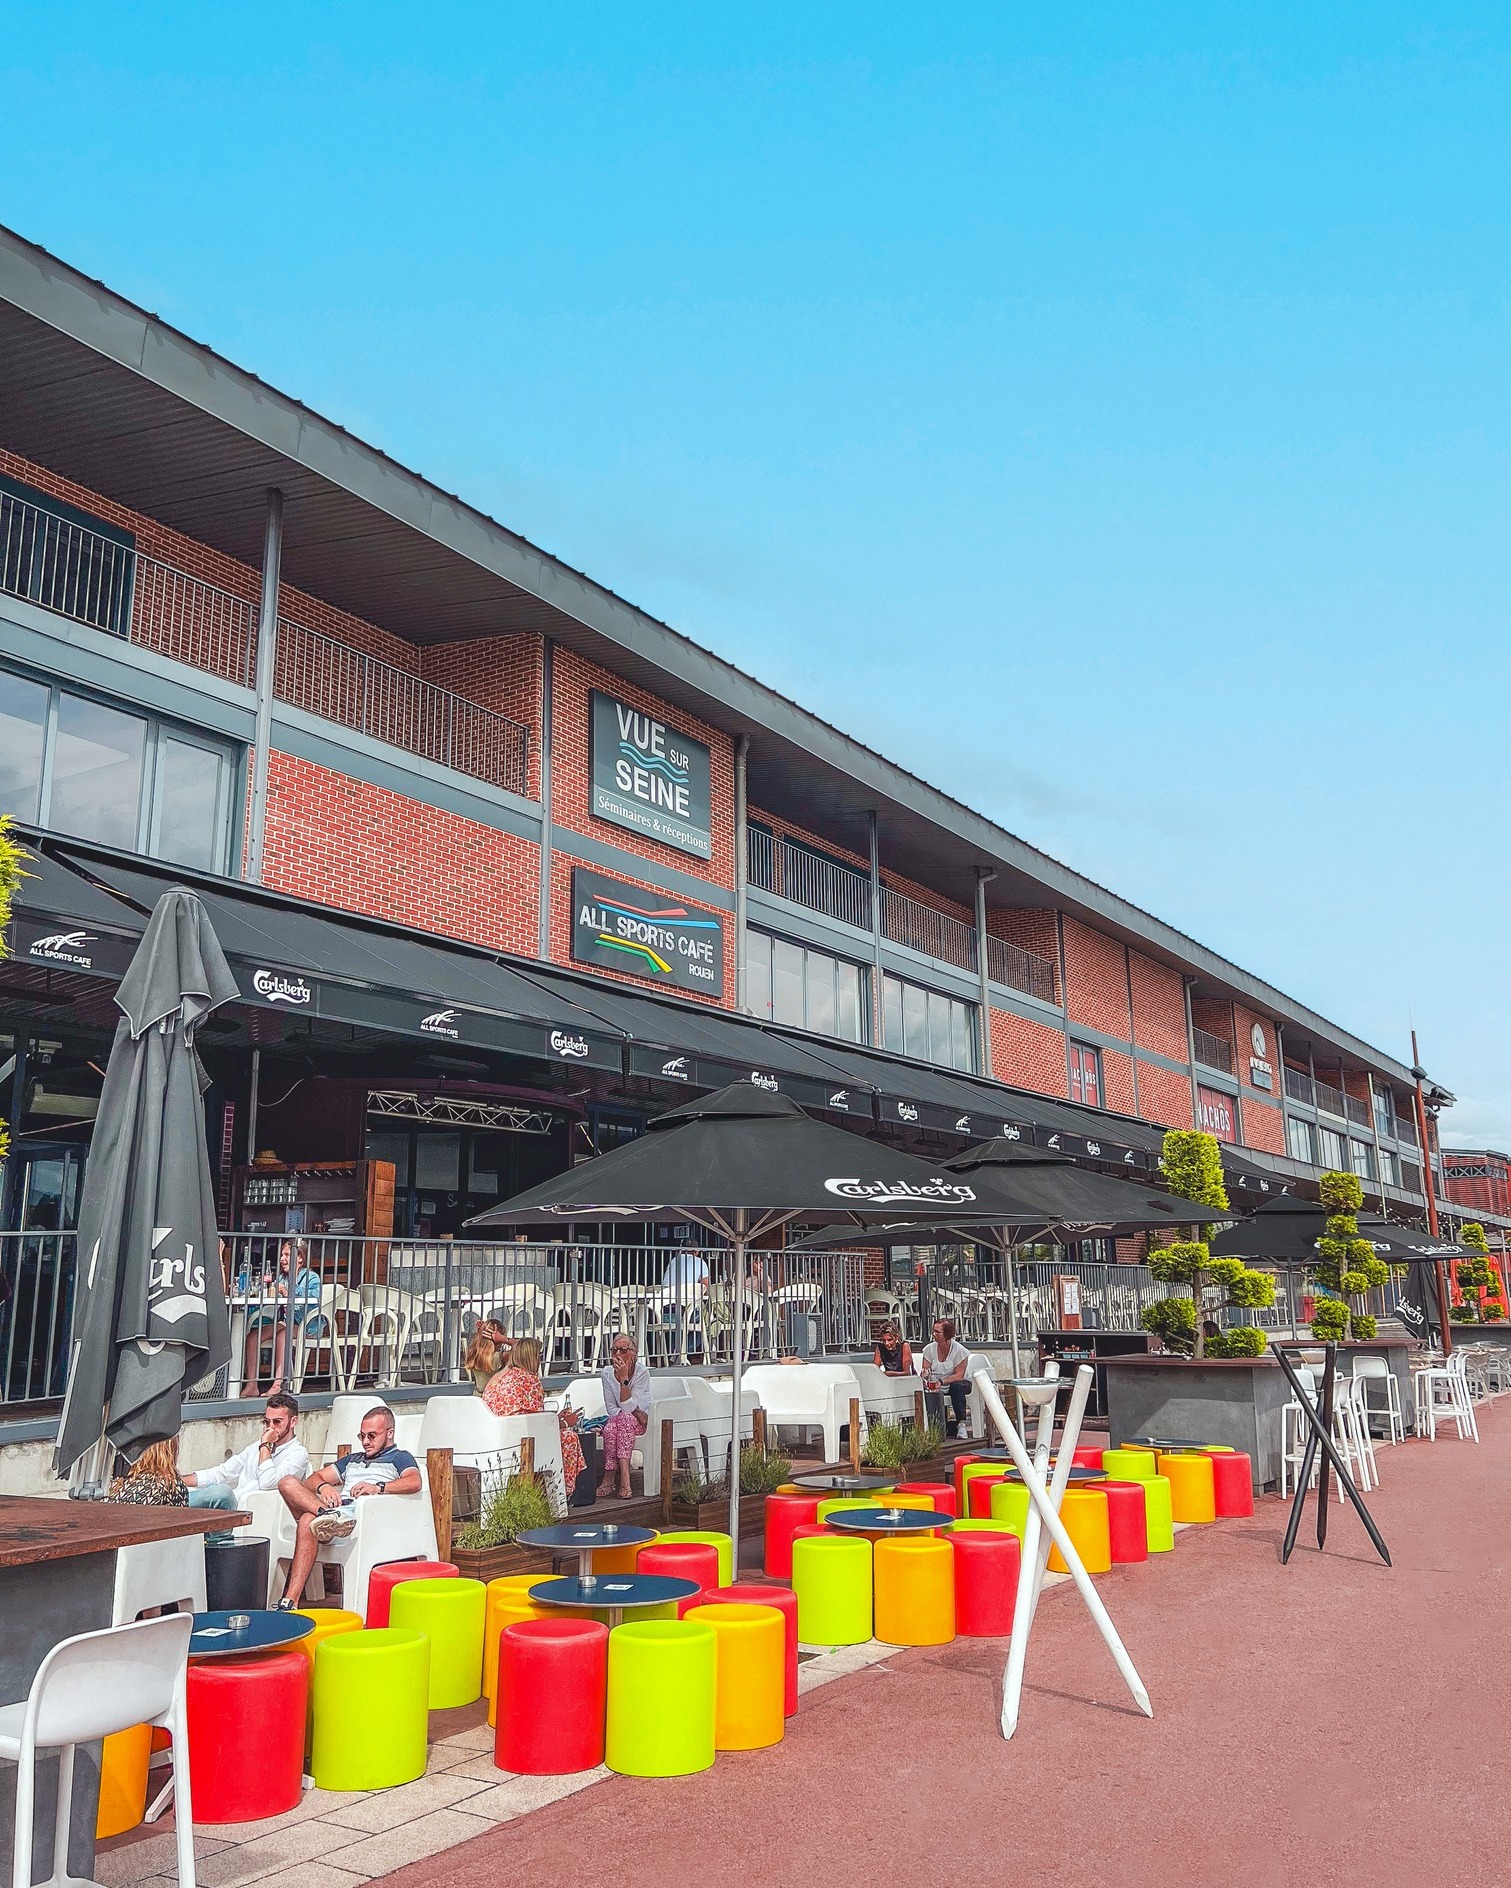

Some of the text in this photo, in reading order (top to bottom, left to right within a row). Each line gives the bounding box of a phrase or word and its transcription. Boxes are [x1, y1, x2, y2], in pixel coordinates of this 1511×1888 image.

[616, 703, 689, 771] VUE SUR
[615, 760, 691, 818] SEINE
[598, 795, 708, 851] Séminaires & réceptions
[579, 905, 714, 964] ALL SPORTS CAFÉ
[29, 947, 44, 956] ALL
[44, 950, 73, 962] SPORTS
[689, 963, 715, 981] ROUEN
[253, 969, 311, 1004] Carlsberg
[551, 1030, 589, 1058] Carlsberg
[824, 1178, 977, 1204] Carlsberg
